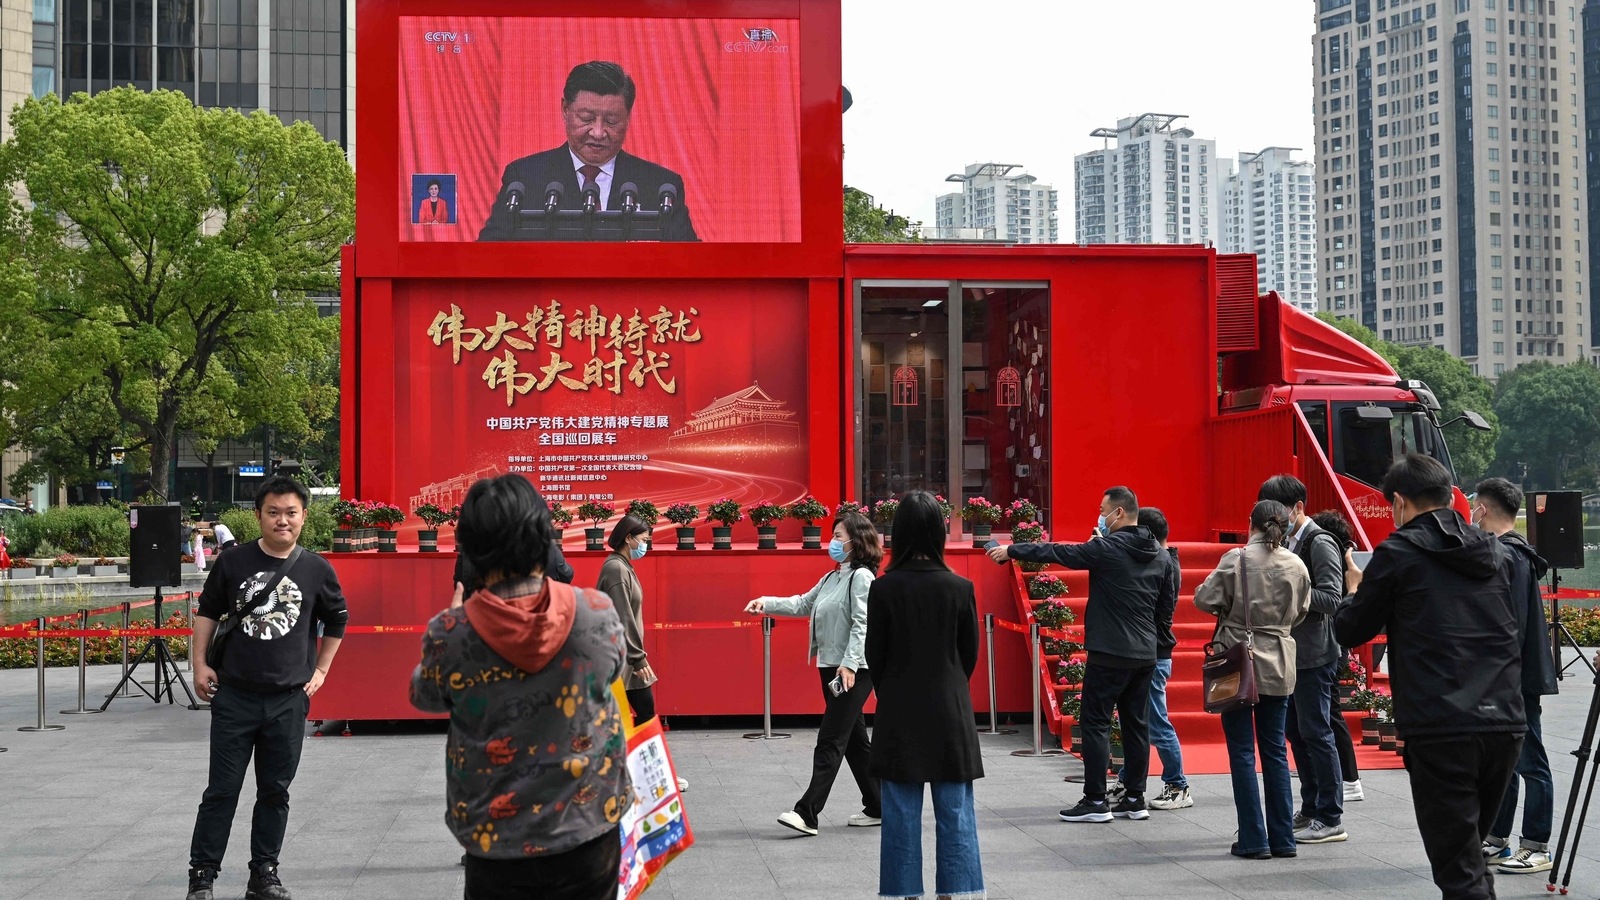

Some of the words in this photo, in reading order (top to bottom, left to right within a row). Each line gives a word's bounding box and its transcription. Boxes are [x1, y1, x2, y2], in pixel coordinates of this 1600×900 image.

[425, 32, 457, 41] CCTV
[427, 299, 702, 364] 伟大精神铸就
[481, 349, 677, 406] 伟大时代
[486, 415, 670, 430] 中国共产党伟大建党精神专题展
[538, 432, 617, 446] 全国巡回展车
